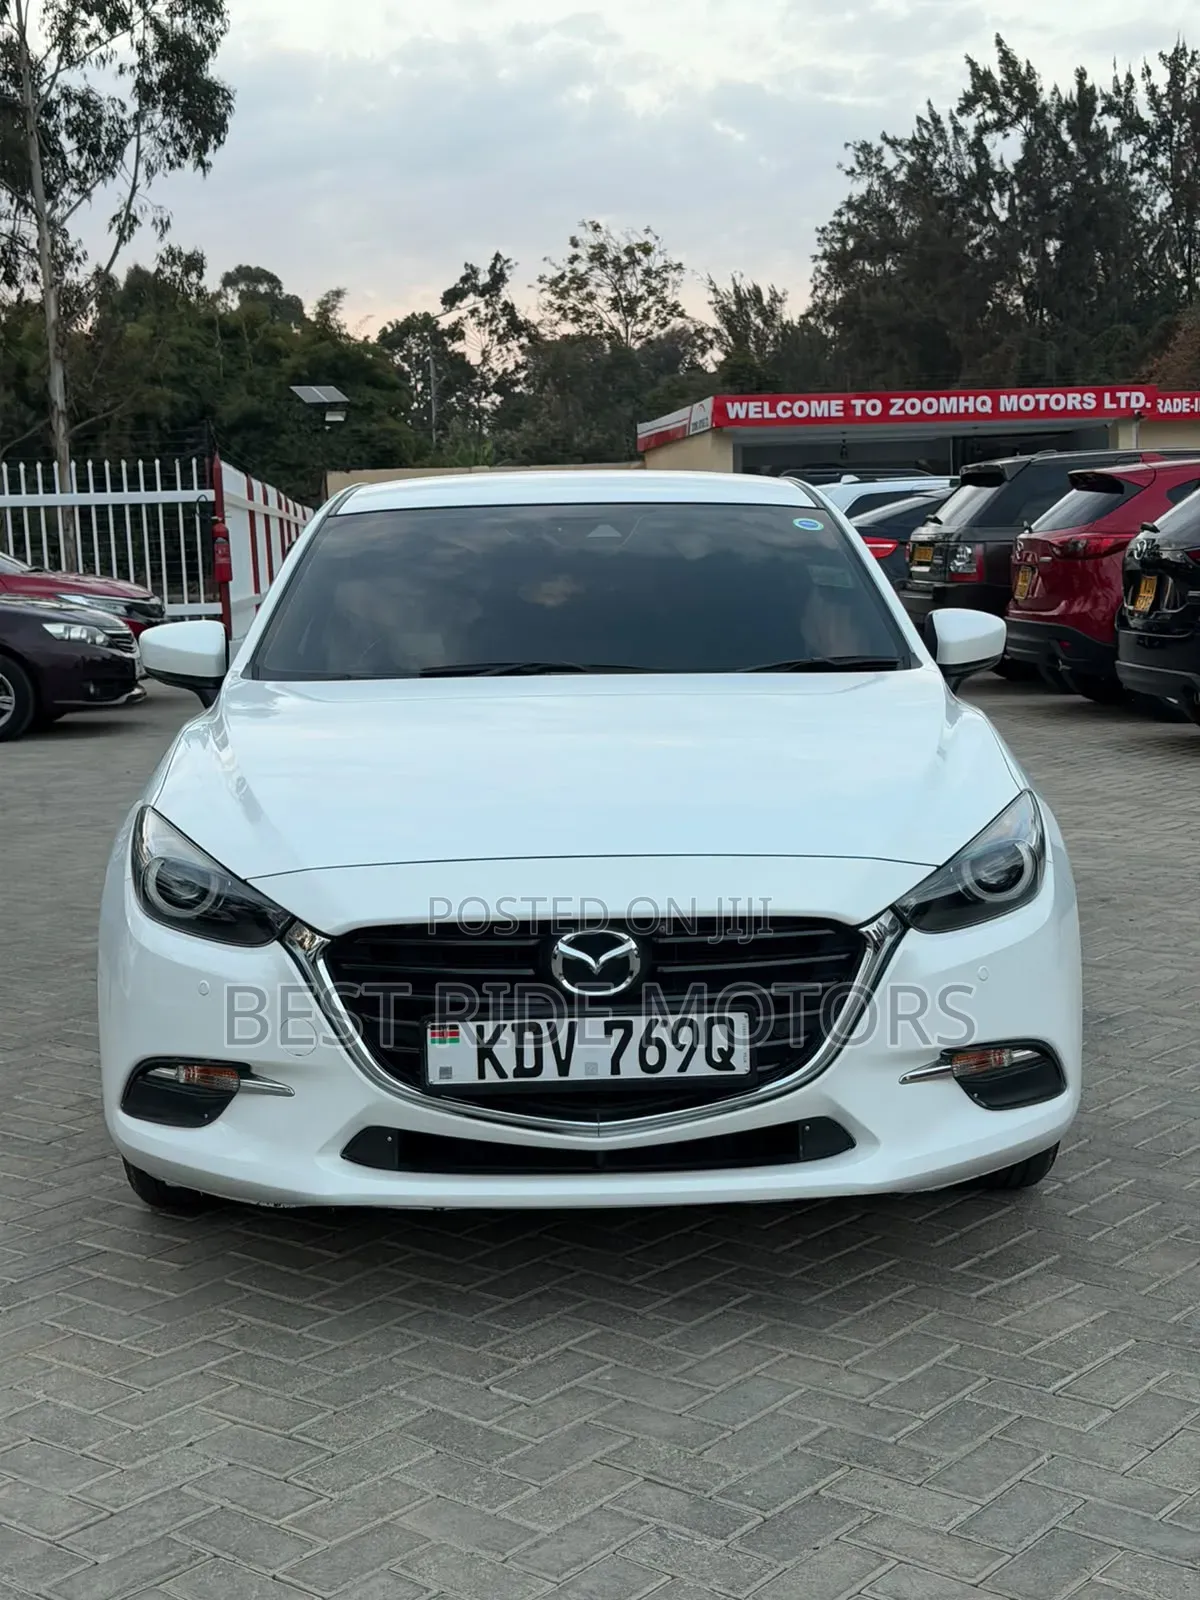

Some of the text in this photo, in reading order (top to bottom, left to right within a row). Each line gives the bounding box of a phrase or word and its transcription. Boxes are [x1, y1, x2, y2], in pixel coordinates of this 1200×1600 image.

[726, 391, 1151, 419] WELCOME TO ZOOMHQ MOTORS LTD.
[1156, 397, 1200, 414] RADE-I
[475, 1020, 578, 1080] KDV
[604, 1015, 737, 1076] 769Q
